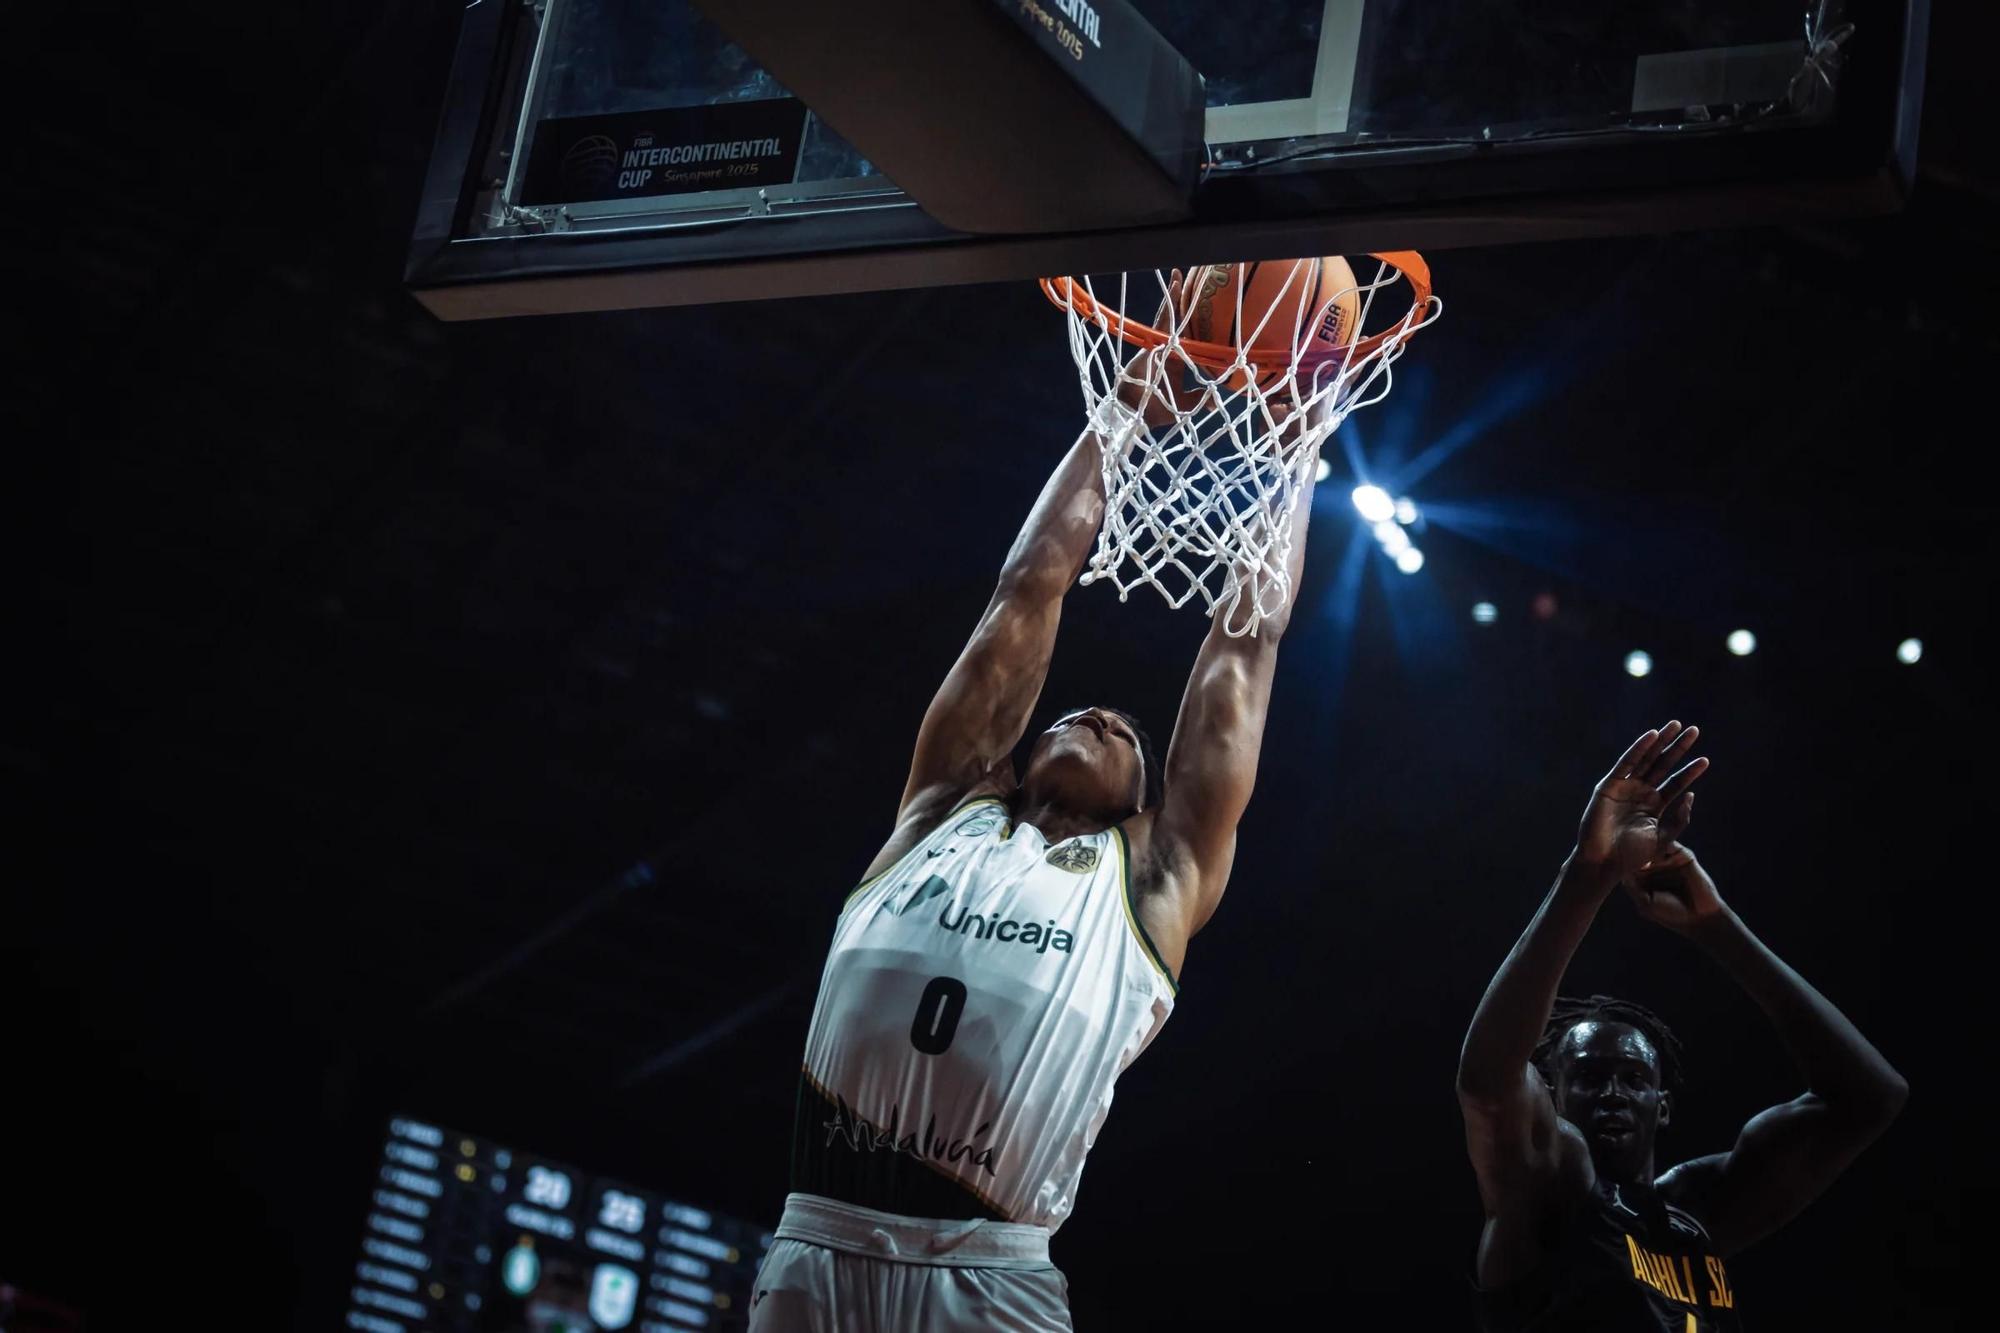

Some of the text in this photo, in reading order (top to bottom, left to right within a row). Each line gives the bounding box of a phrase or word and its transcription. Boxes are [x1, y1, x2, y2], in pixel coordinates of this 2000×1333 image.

[1056, 20, 1084, 61] 2025
[622, 137, 782, 169] INTERCONTINENTAL
[634, 137, 653, 148] FIBA
[618, 169, 653, 189] CUP
[727, 162, 760, 178] 2025
[1318, 304, 1341, 342] FIBA
[939, 906, 1074, 954] Unicaja
[910, 975, 967, 1055] 0
[823, 1093, 996, 1177] Andalucía
[1705, 1255, 1733, 1309] SC
